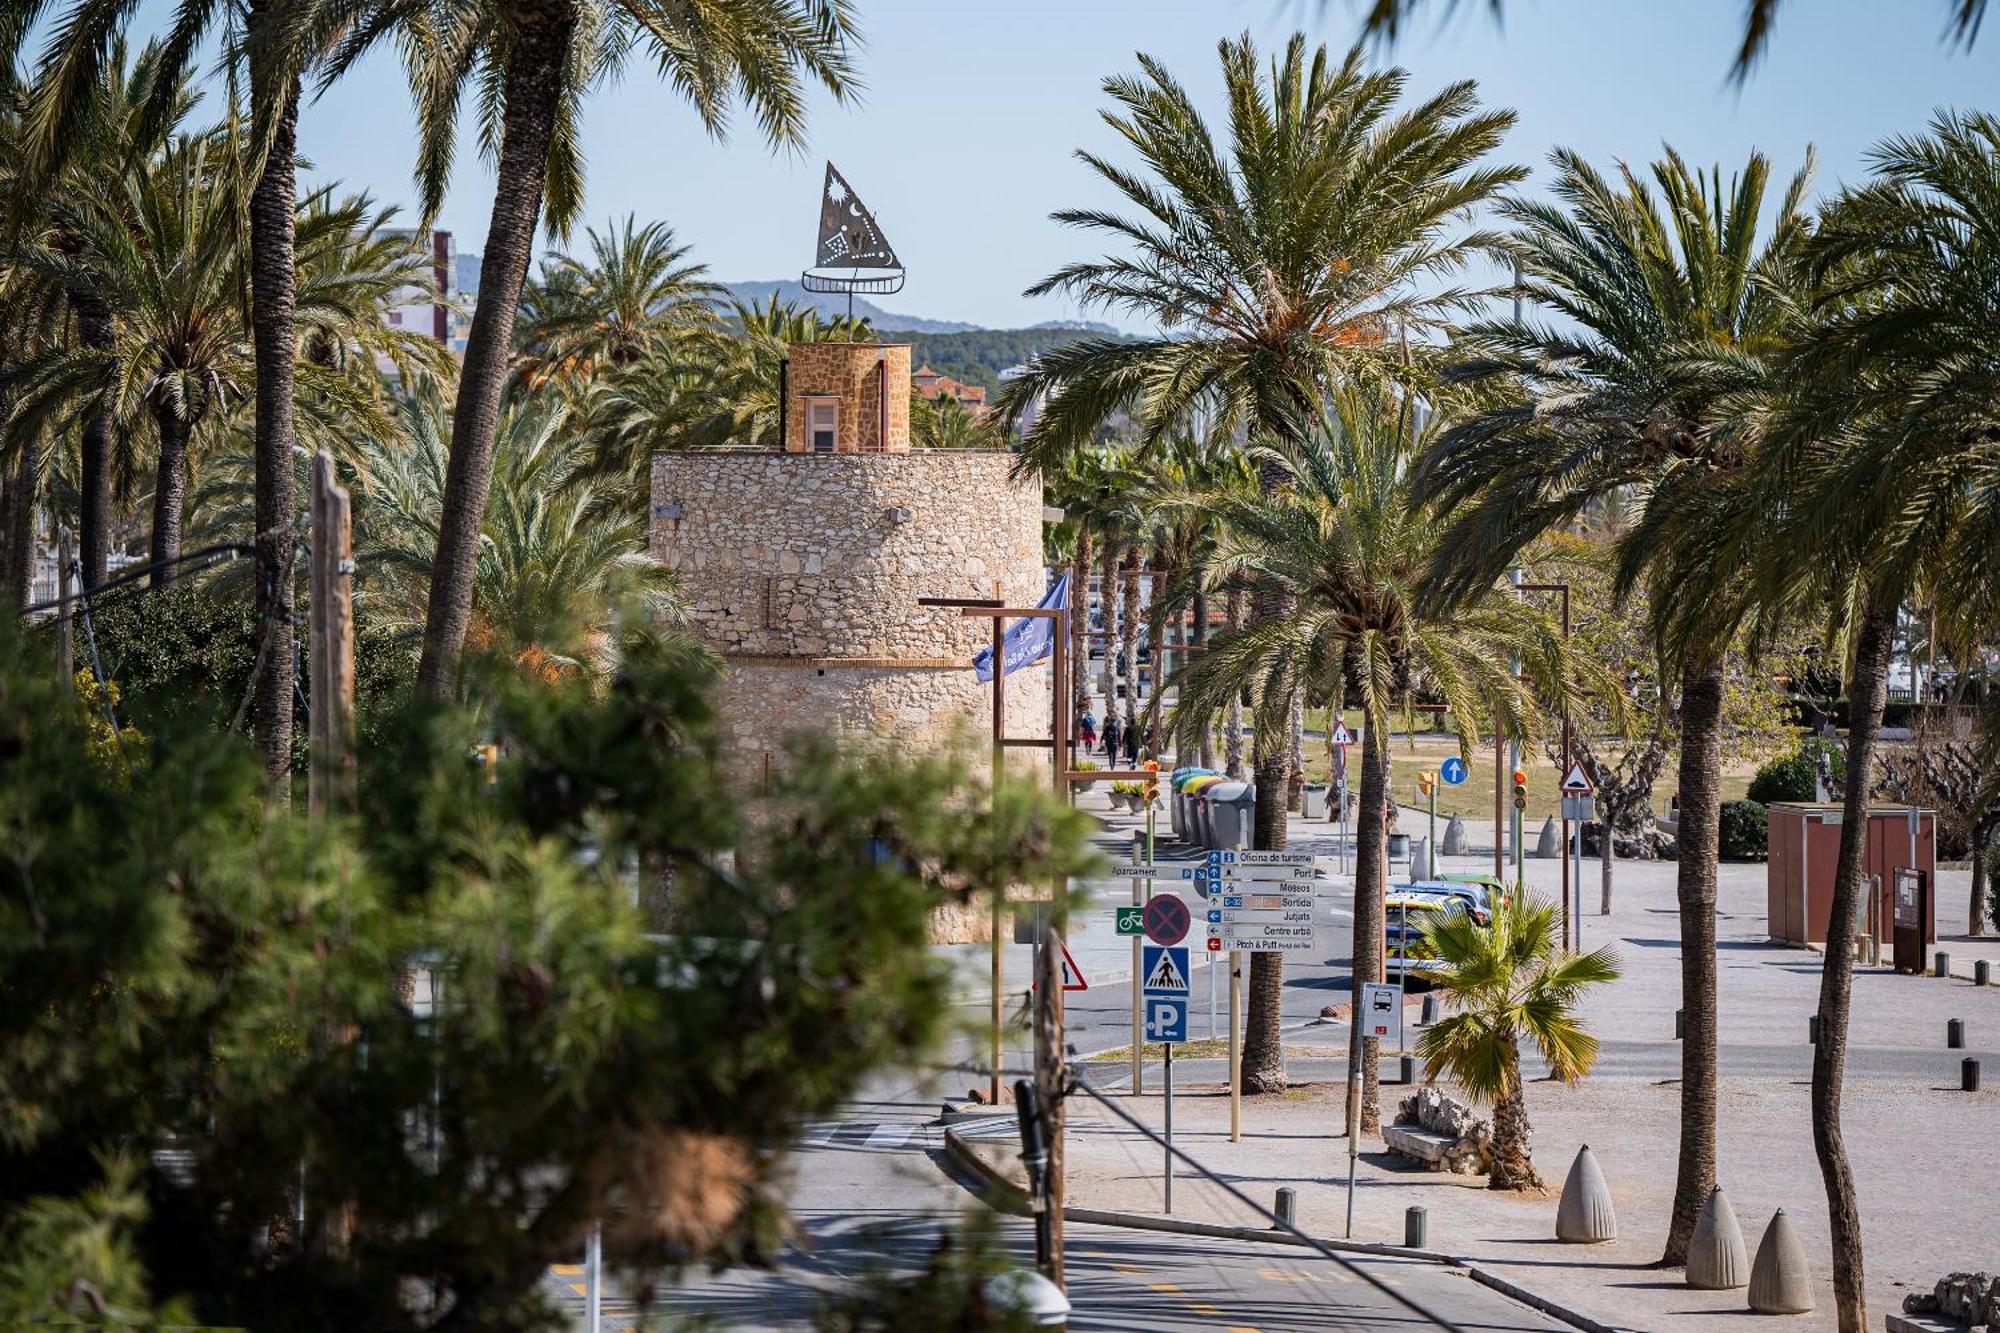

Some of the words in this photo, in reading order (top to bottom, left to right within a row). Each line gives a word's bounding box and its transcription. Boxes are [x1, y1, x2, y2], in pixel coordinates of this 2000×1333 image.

[1240, 852, 1268, 862] Oficina
[1269, 853, 1279, 862] de
[1282, 853, 1311, 863] turisme
[1112, 866, 1157, 877] Aparcament
[1294, 868, 1312, 878] Port
[1280, 883, 1310, 893] Mossos
[1282, 898, 1311, 907] Sortida
[1283, 912, 1310, 922] Jutjats
[1264, 926, 1290, 935] Centre
[1236, 940, 1254, 949] Pitch
[1255, 941, 1261, 949] &
[1262, 940, 1277, 949] Putt
[1155, 1005, 1178, 1037] P
